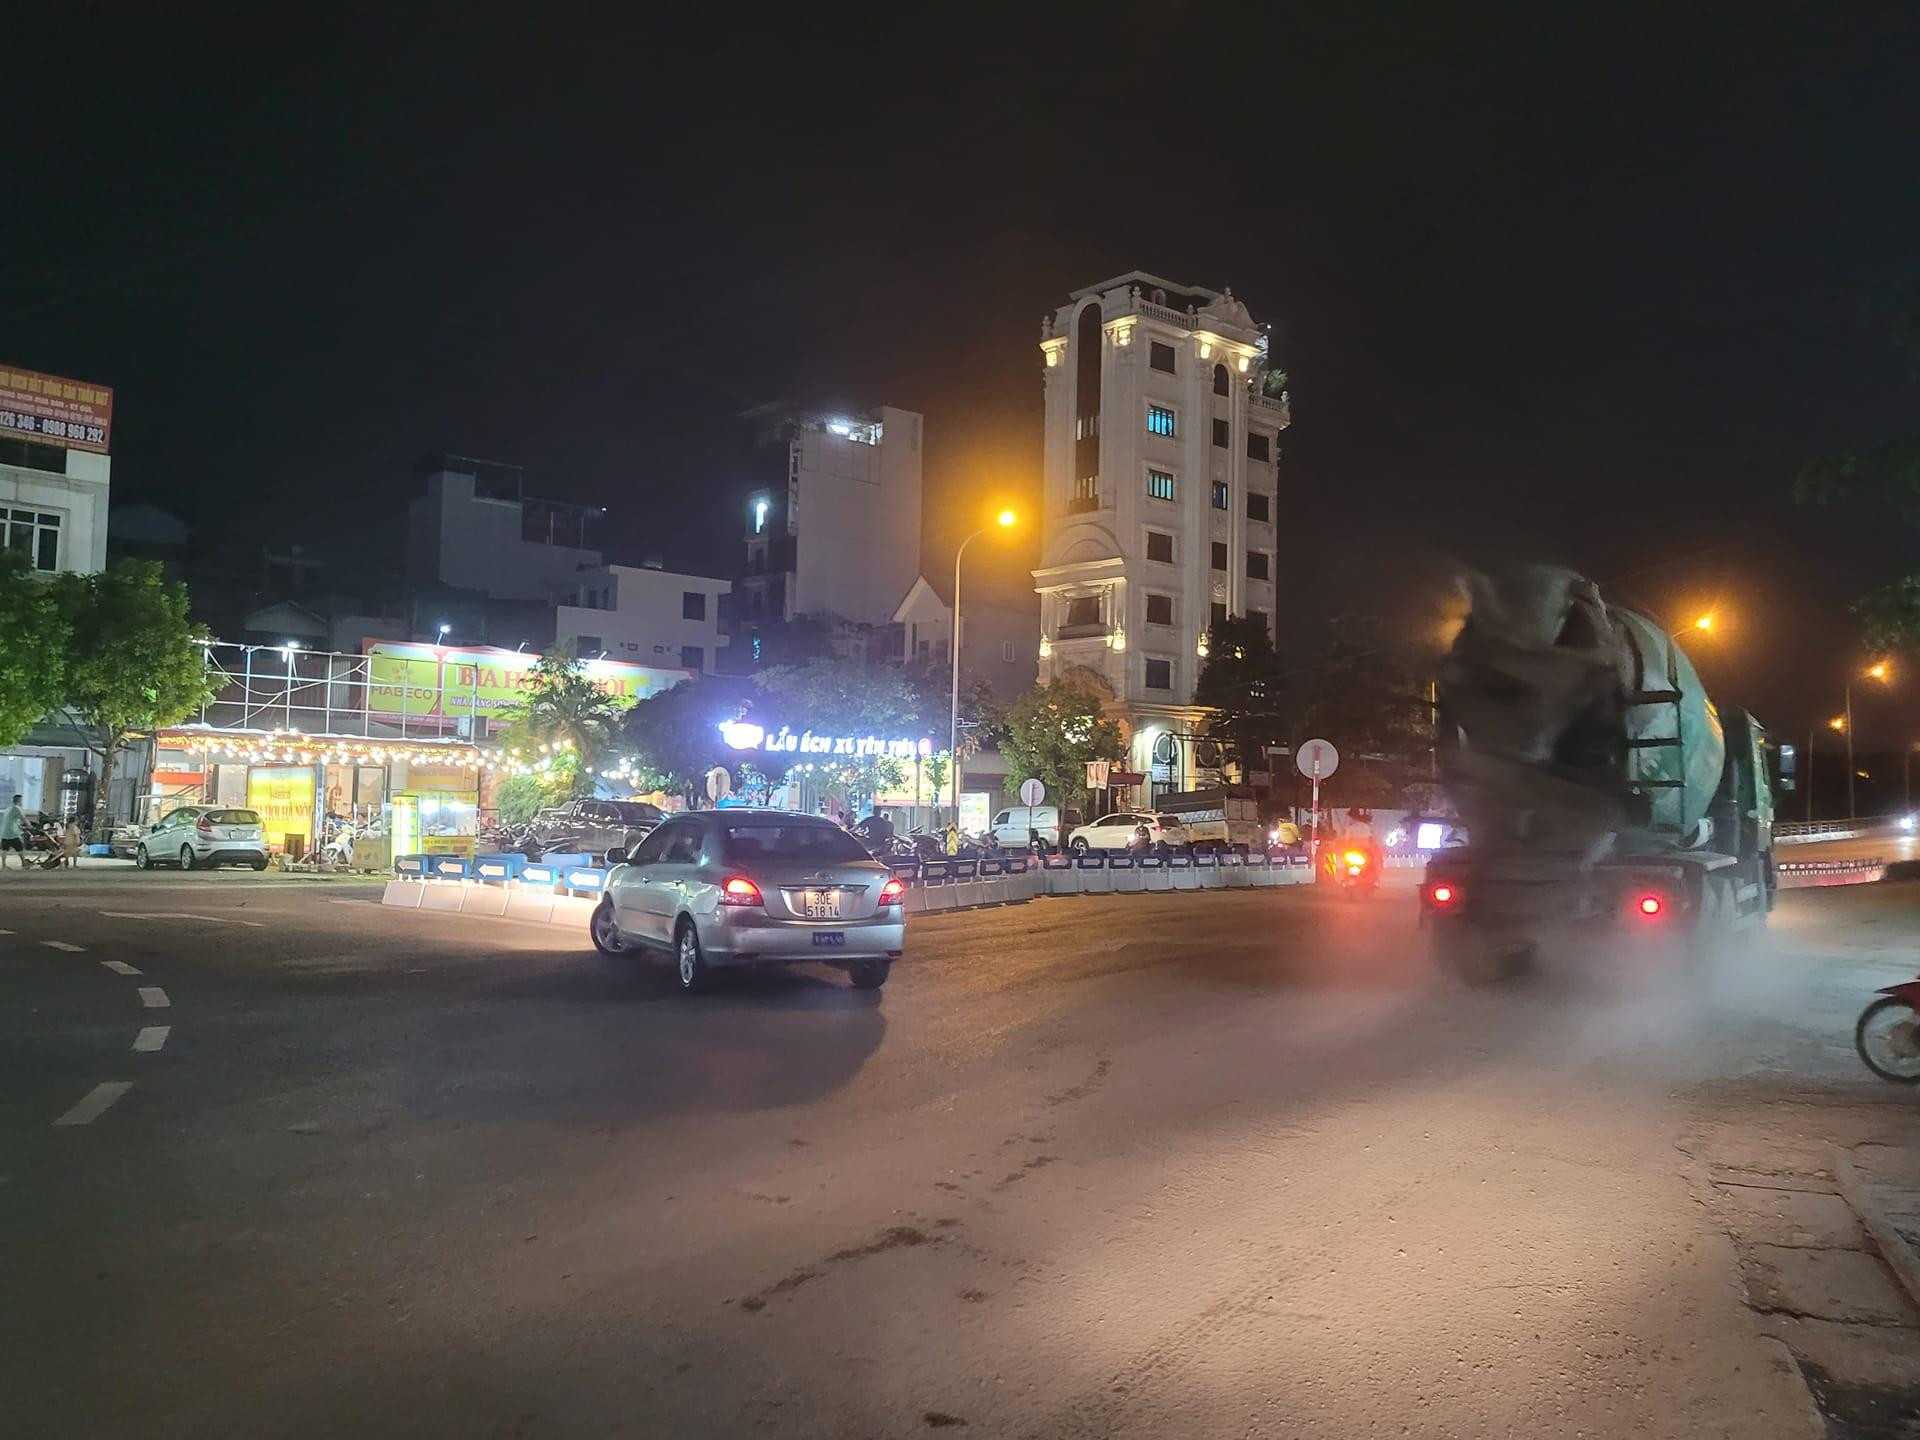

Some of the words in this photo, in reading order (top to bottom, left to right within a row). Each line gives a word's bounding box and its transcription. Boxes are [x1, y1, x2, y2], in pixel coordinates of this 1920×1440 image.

[87, 427, 104, 444] 292
[372, 686, 433, 700] HABECO
[814, 893, 832, 905] 30E
